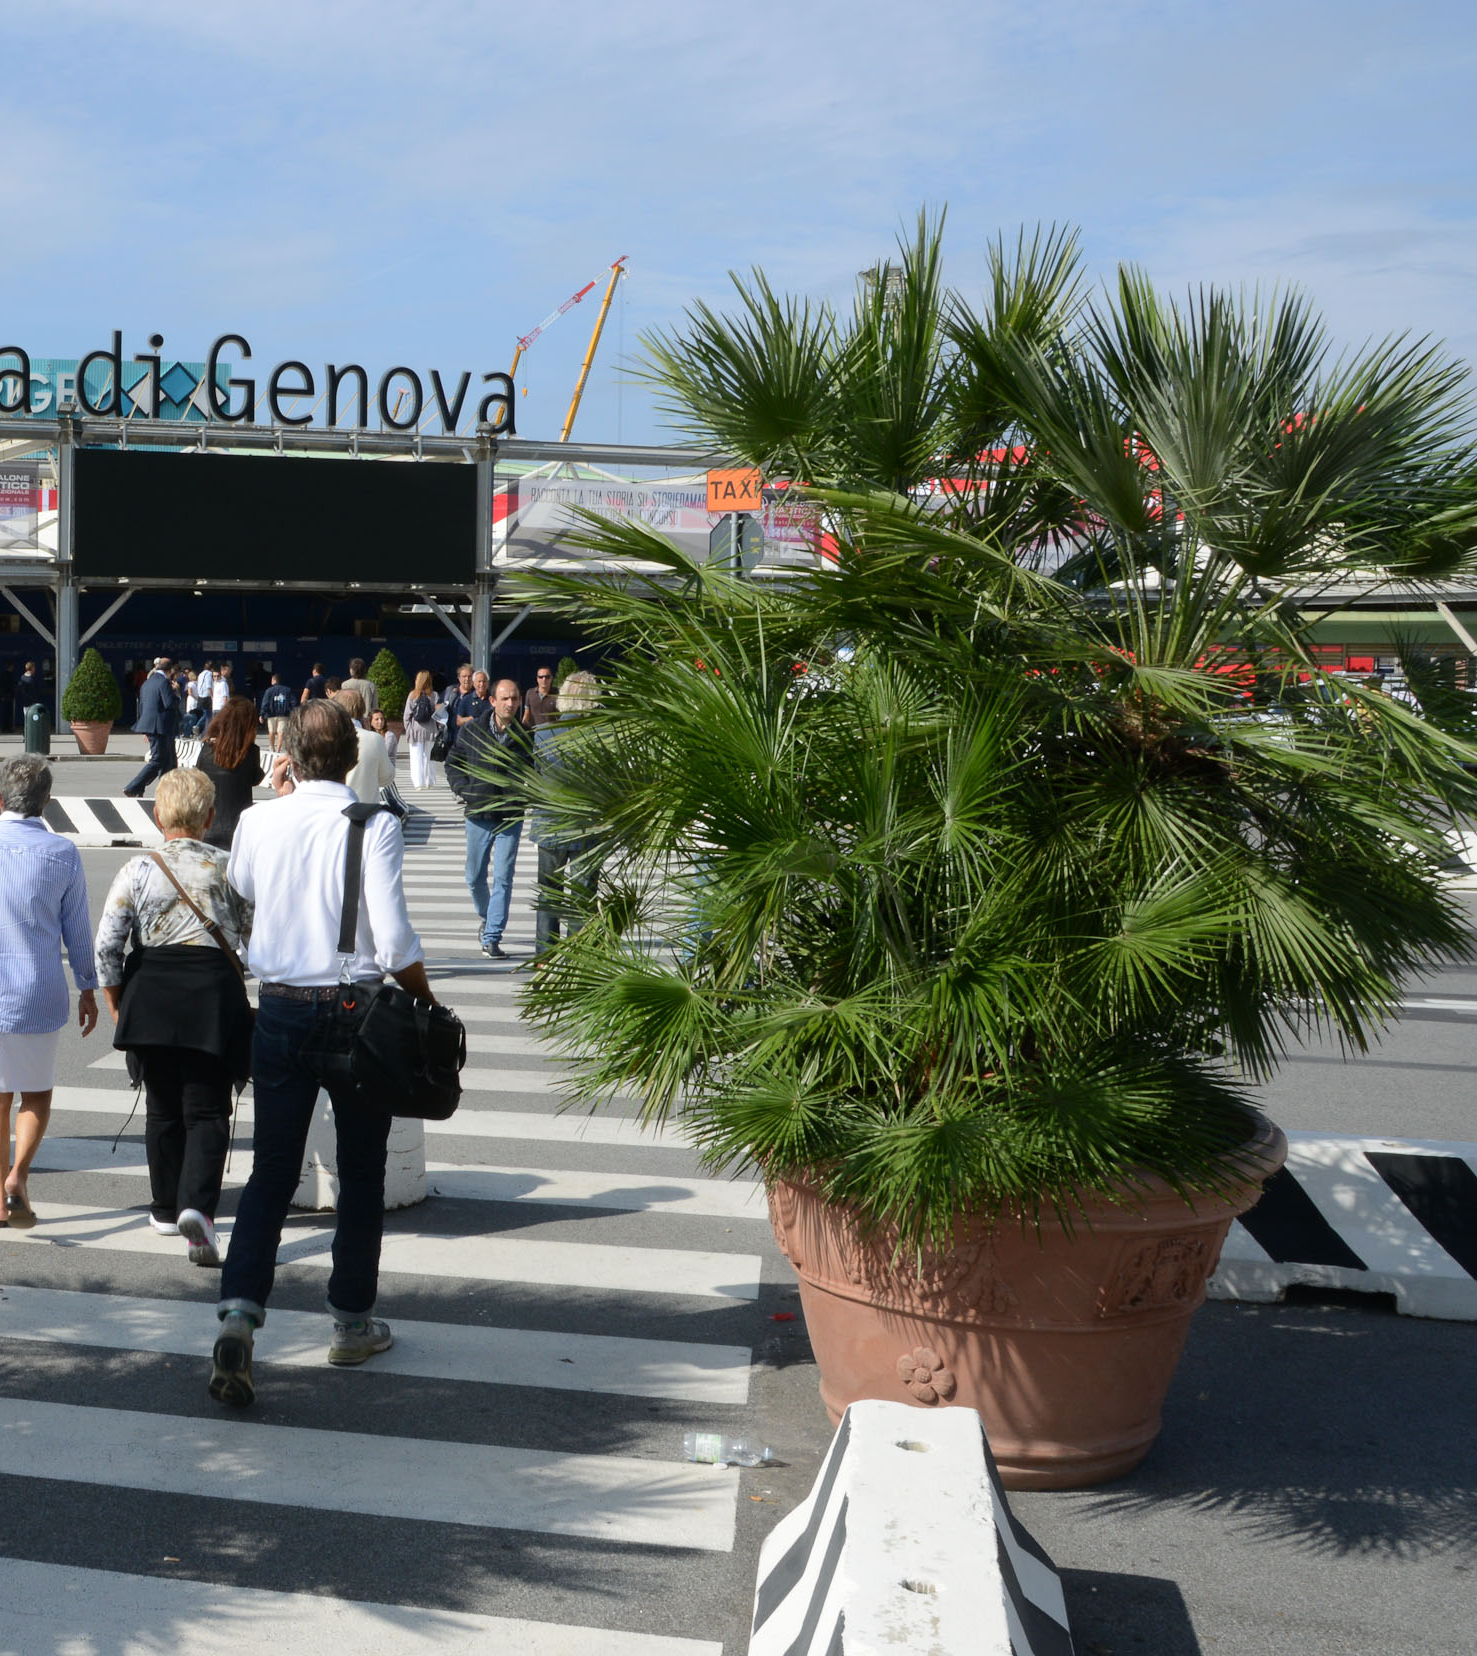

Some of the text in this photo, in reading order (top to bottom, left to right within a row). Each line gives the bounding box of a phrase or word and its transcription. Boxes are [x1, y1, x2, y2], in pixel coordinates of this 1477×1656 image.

[75, 329, 164, 419] di
[206, 333, 517, 436] Genova
[575, 489, 585, 505] LA
[589, 490, 603, 506] TUA
[607, 490, 634, 507] STORIA
[637, 491, 648, 508] SU
